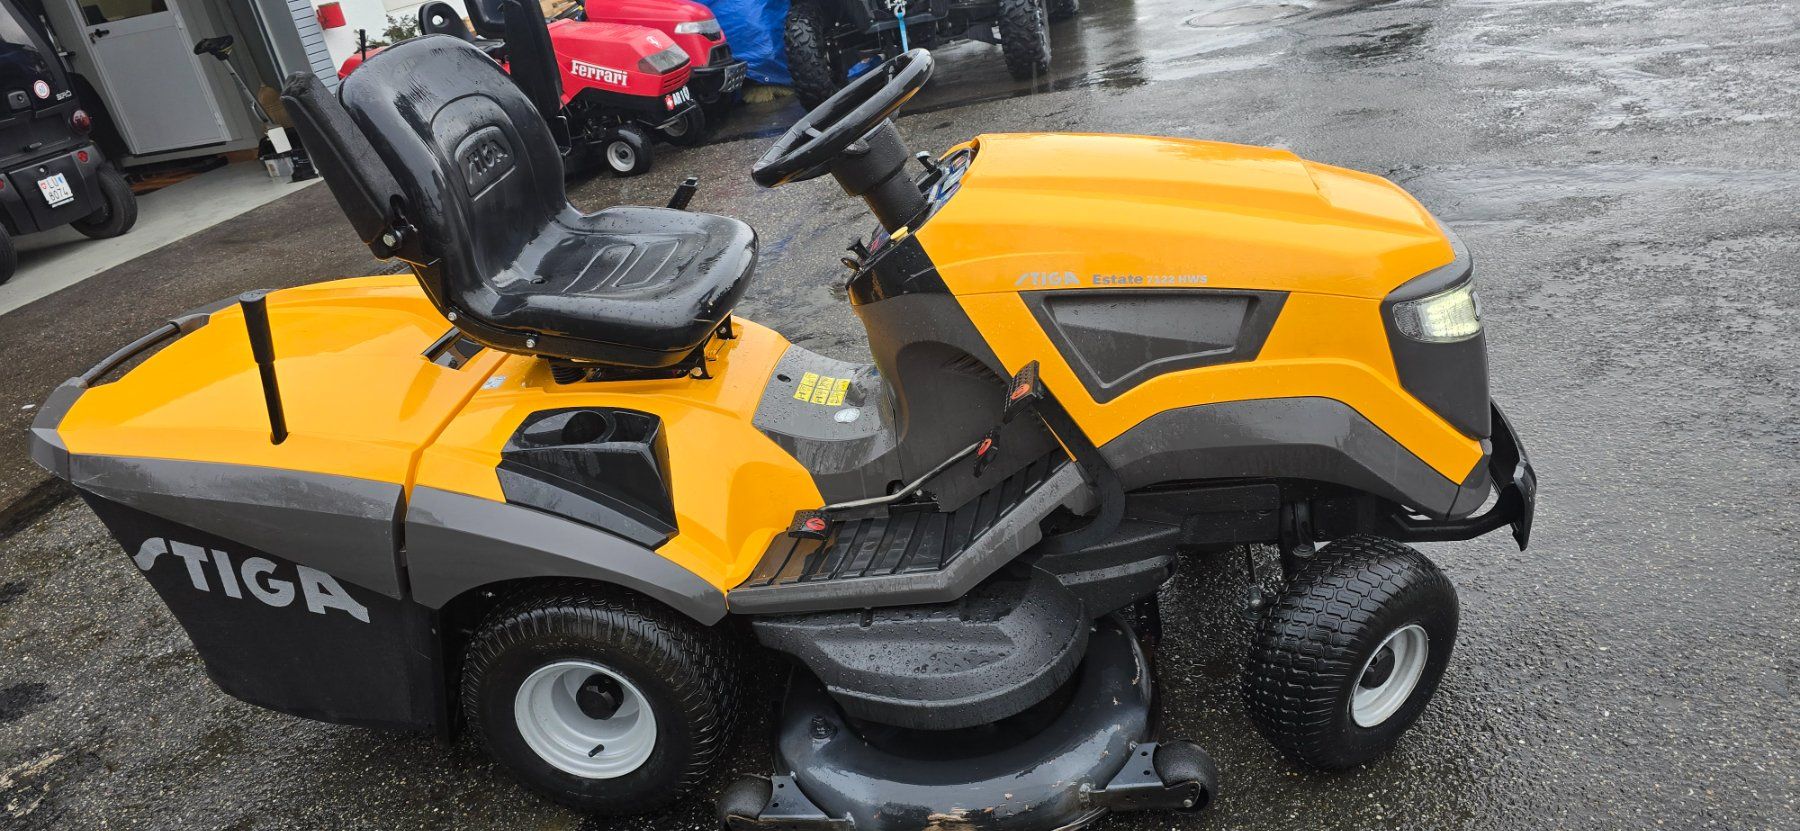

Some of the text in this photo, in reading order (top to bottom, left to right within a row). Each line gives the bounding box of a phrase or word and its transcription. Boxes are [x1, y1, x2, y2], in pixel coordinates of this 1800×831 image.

[571, 59, 628, 86] Ferrari
[1015, 271, 1208, 286] STIGA Estate 7122 HWS
[133, 537, 370, 624] STIGA
